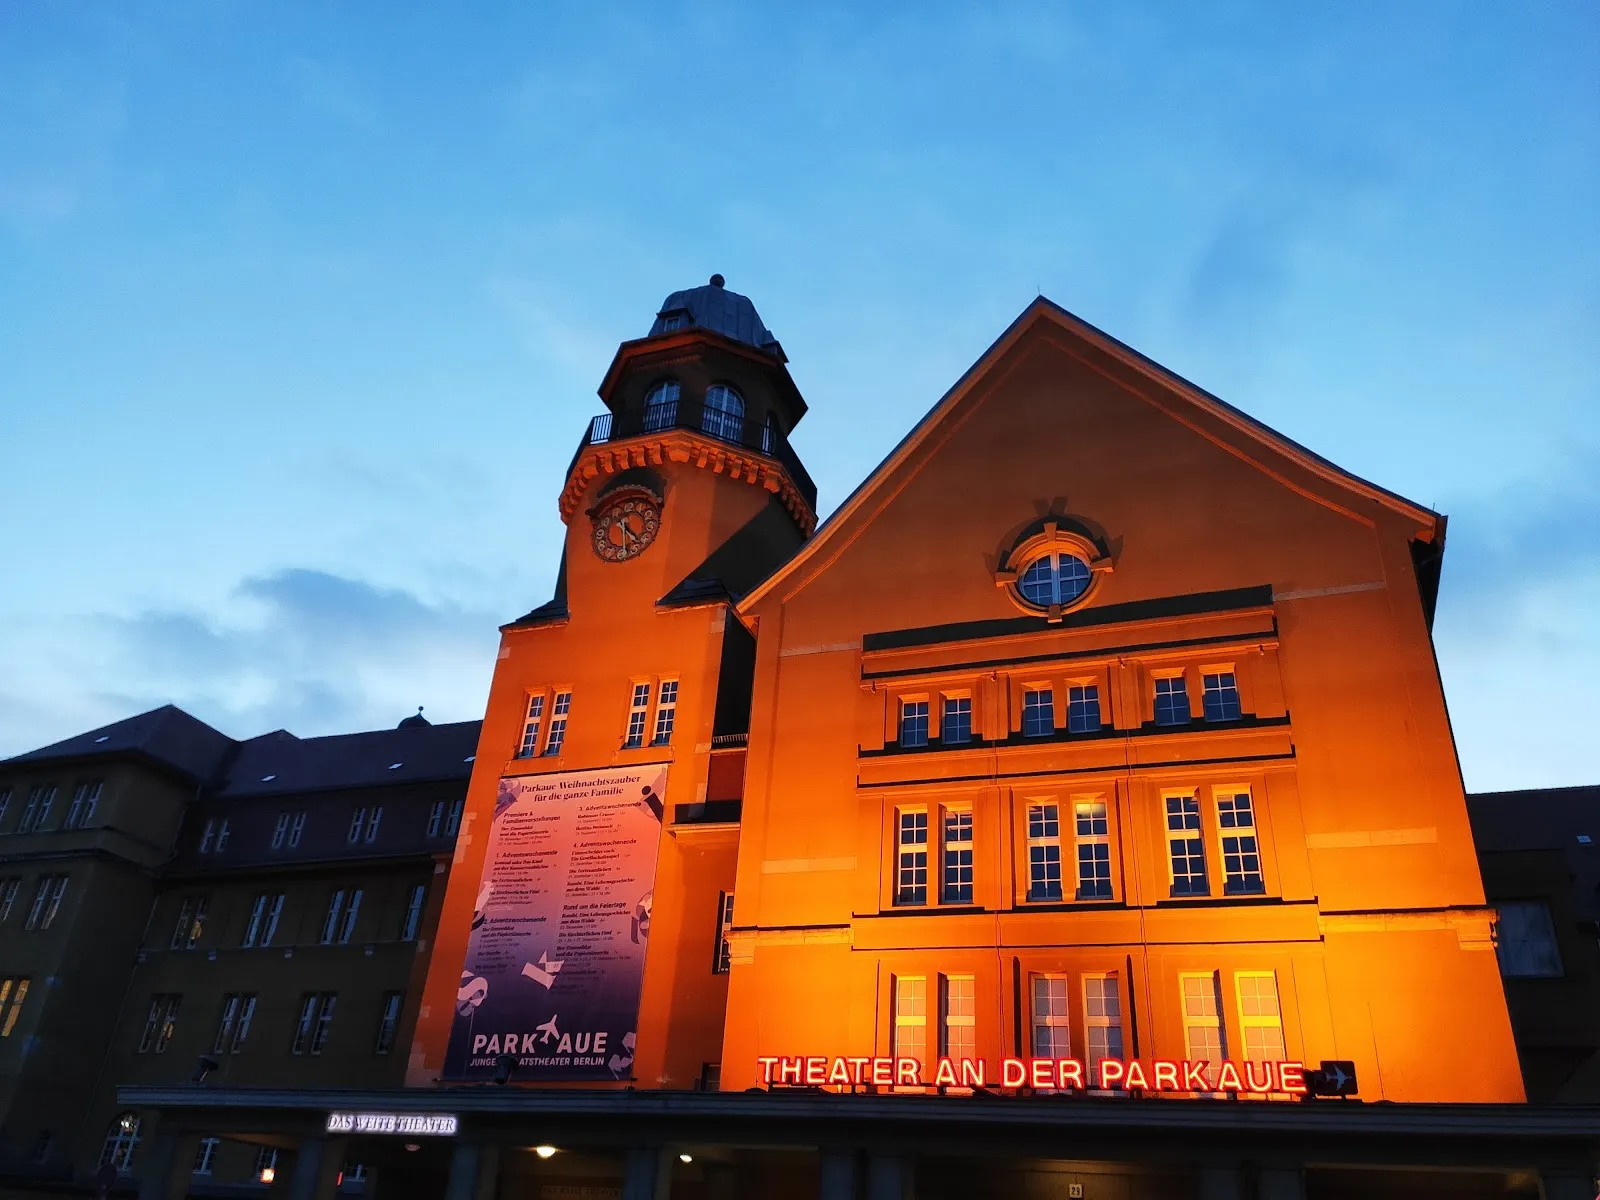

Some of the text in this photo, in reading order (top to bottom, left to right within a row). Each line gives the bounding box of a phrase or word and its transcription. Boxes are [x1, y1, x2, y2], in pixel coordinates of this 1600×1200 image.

[521, 776, 641, 793] Parkaue Weihnachtszauber
[534, 787, 624, 802] für die ganze Familie
[585, 802, 642, 811] Adventswochenende
[580, 839, 637, 848] Adventswochenende
[472, 1032, 608, 1054] PARK AUE
[470, 1058, 497, 1066] JUNGE
[573, 1057, 605, 1066] BERLIN
[757, 1056, 1307, 1093] THEATER AN DER PARKAUE
[327, 1114, 457, 1132] DAS WEITE THEATER
